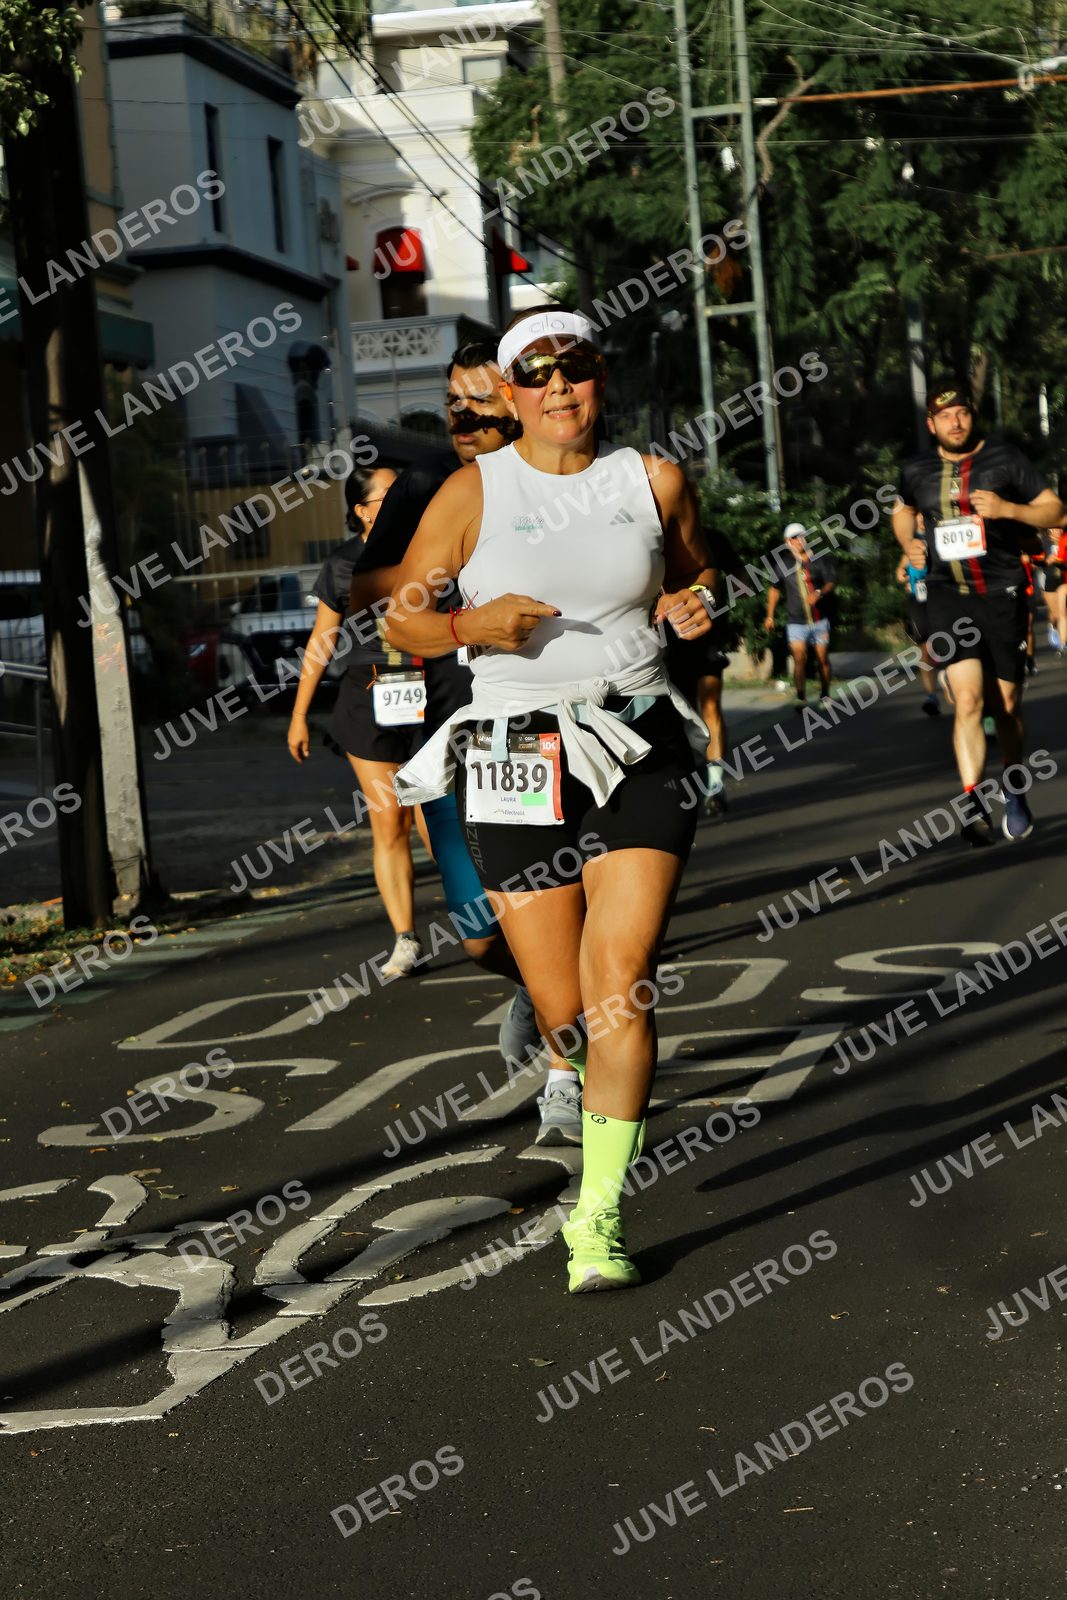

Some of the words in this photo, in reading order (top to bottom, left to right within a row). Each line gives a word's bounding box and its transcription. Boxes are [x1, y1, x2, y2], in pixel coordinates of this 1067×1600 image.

[943, 529, 974, 545] 8019
[383, 688, 423, 706] 9749
[470, 762, 548, 793] 11839
